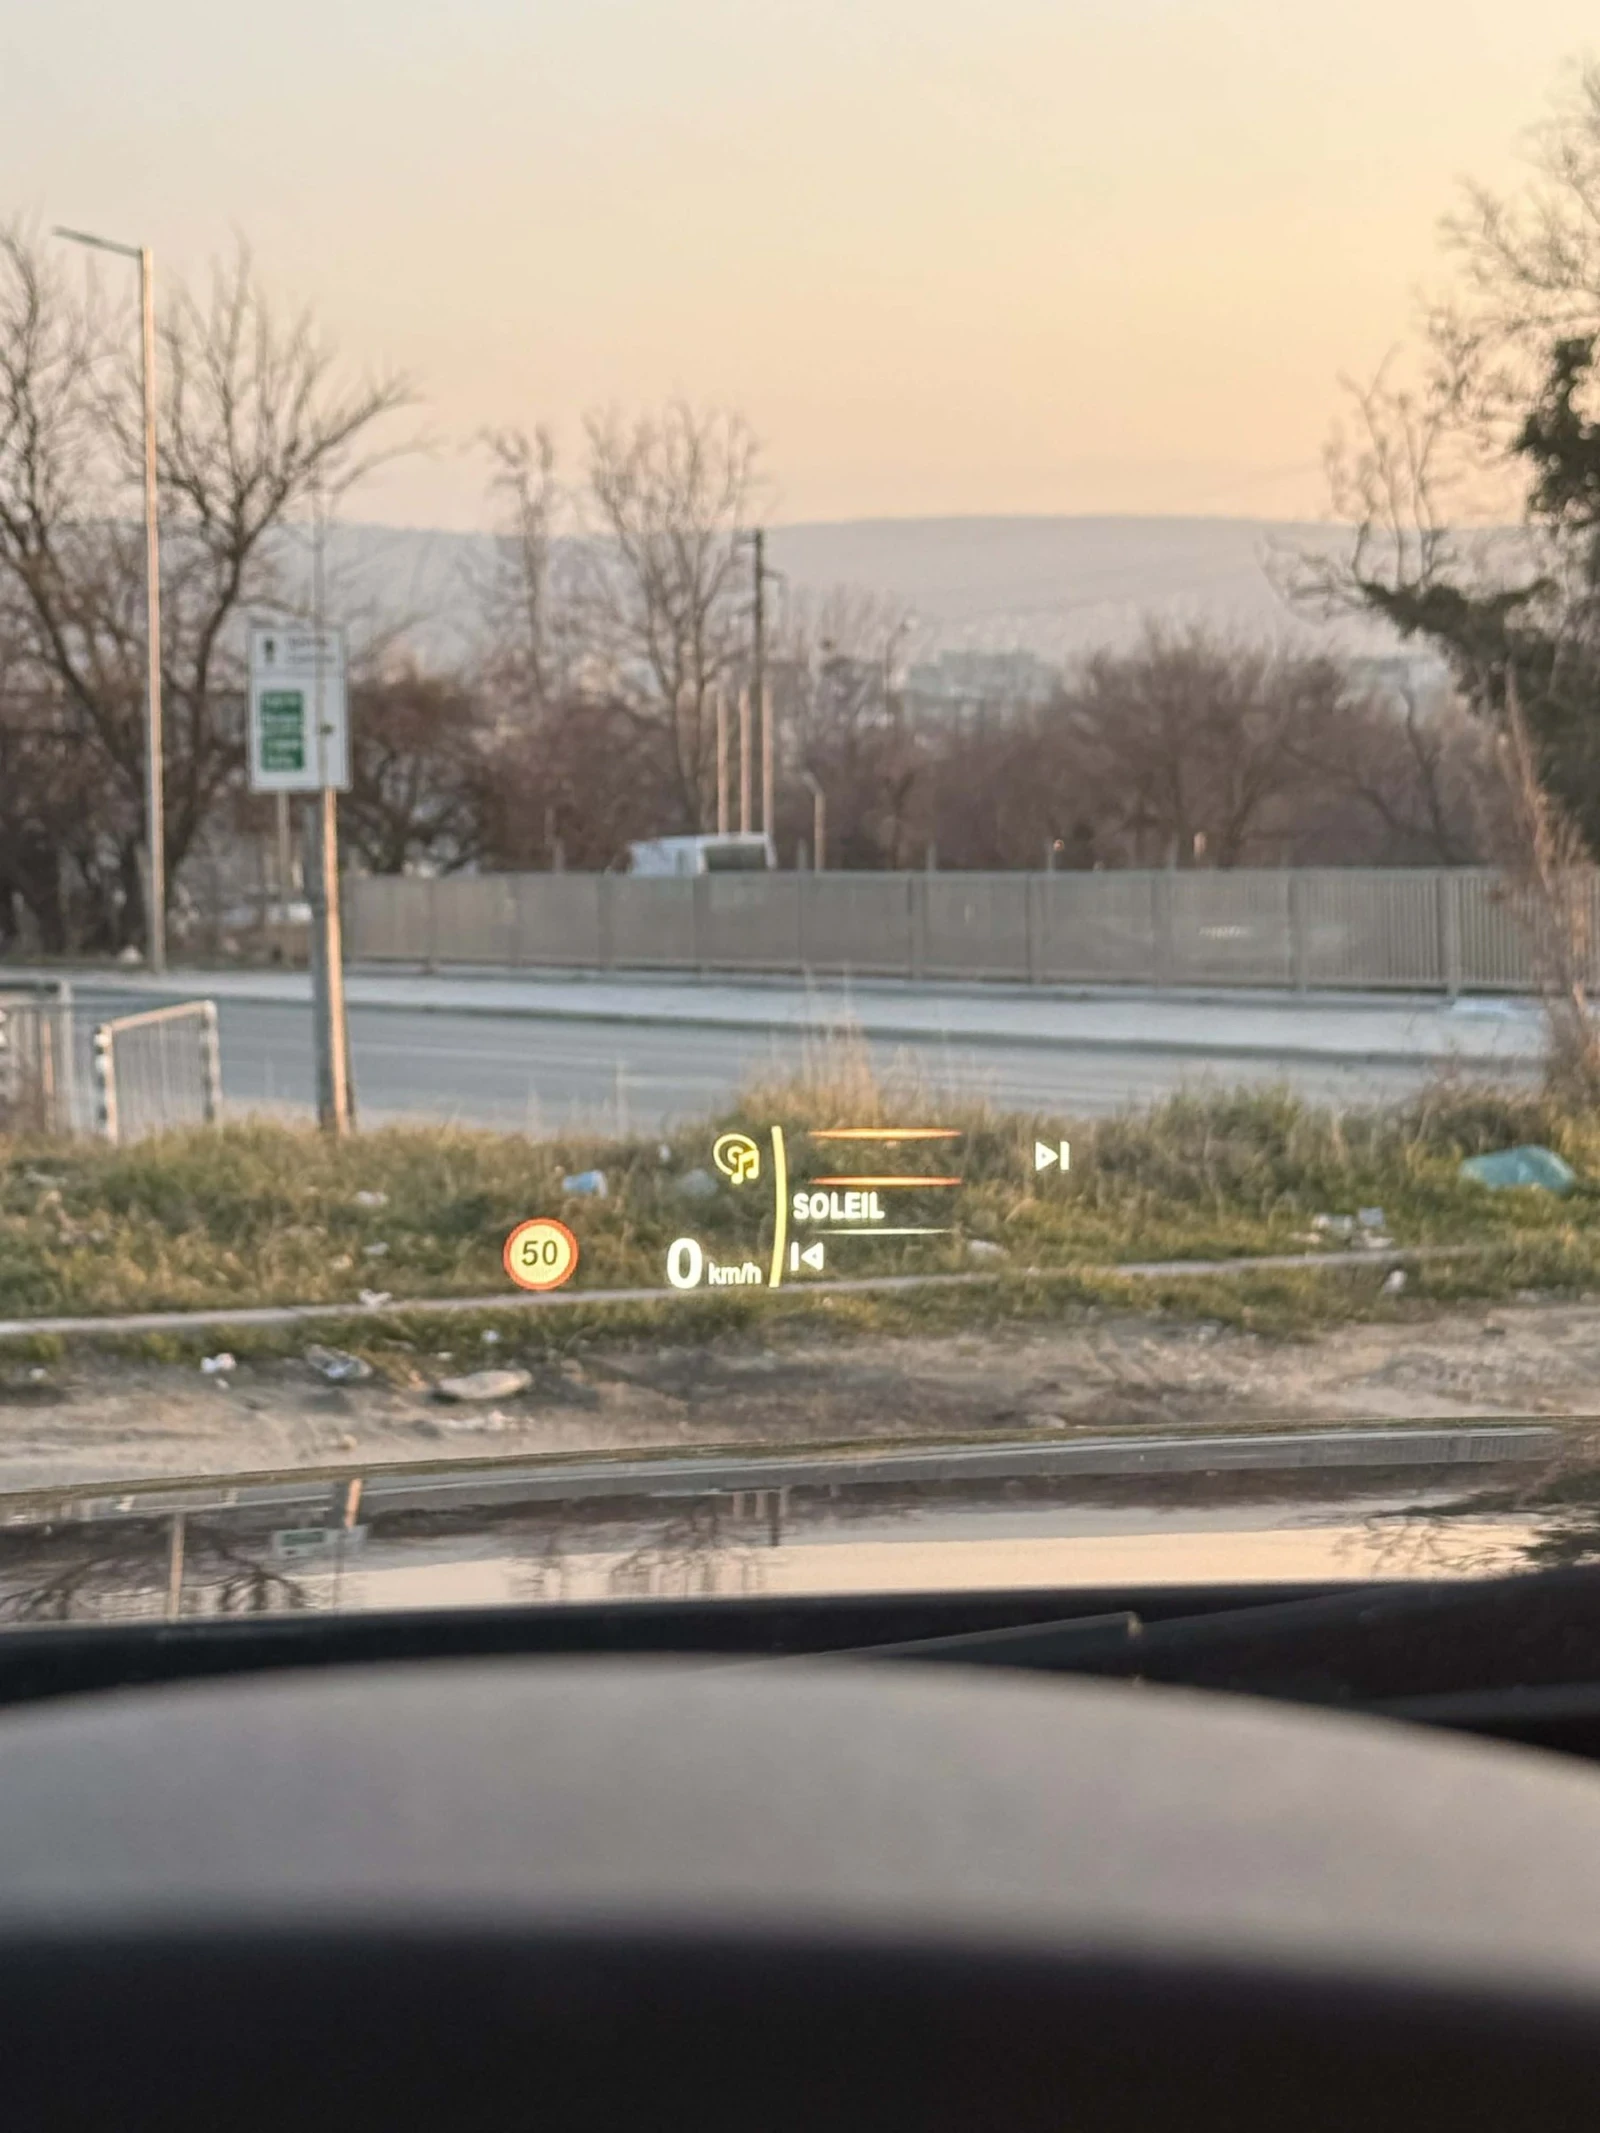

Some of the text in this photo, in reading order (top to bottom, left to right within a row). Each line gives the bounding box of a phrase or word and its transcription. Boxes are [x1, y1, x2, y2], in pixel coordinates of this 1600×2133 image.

[793, 1192, 885, 1220] SOLEIL
[521, 1240, 558, 1266] 50
[667, 1237, 762, 1289] 0 km/h
